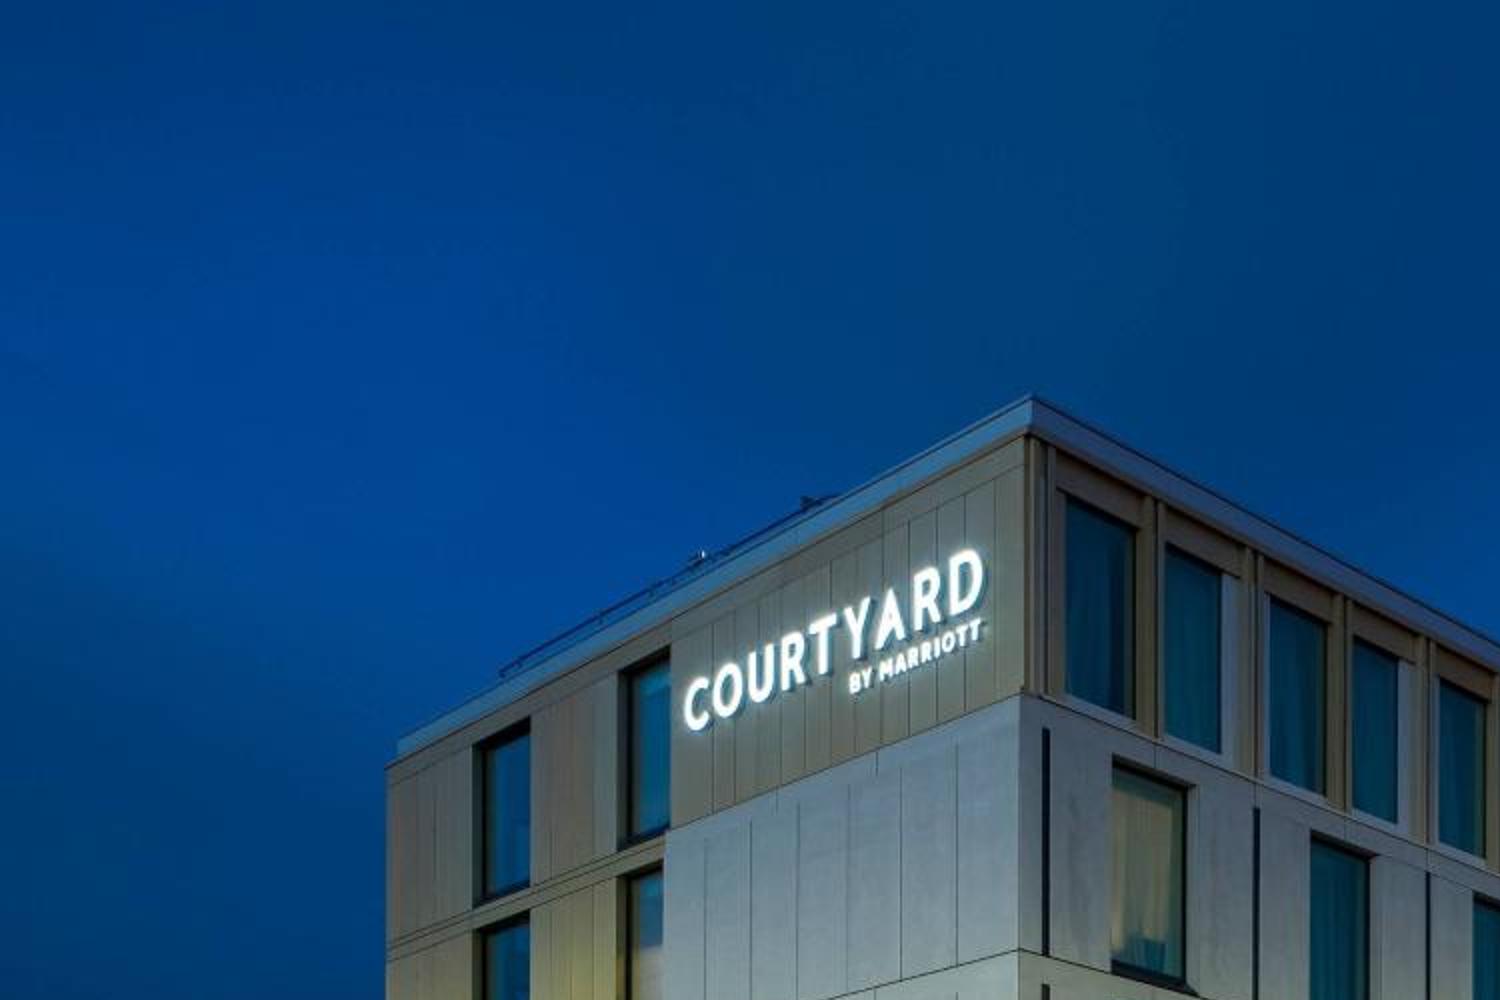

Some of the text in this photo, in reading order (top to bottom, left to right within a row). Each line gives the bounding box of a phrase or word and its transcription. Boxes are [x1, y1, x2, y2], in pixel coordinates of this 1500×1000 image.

[683, 548, 984, 731] COURTYARD
[849, 617, 981, 694] BY MARRIOTT
